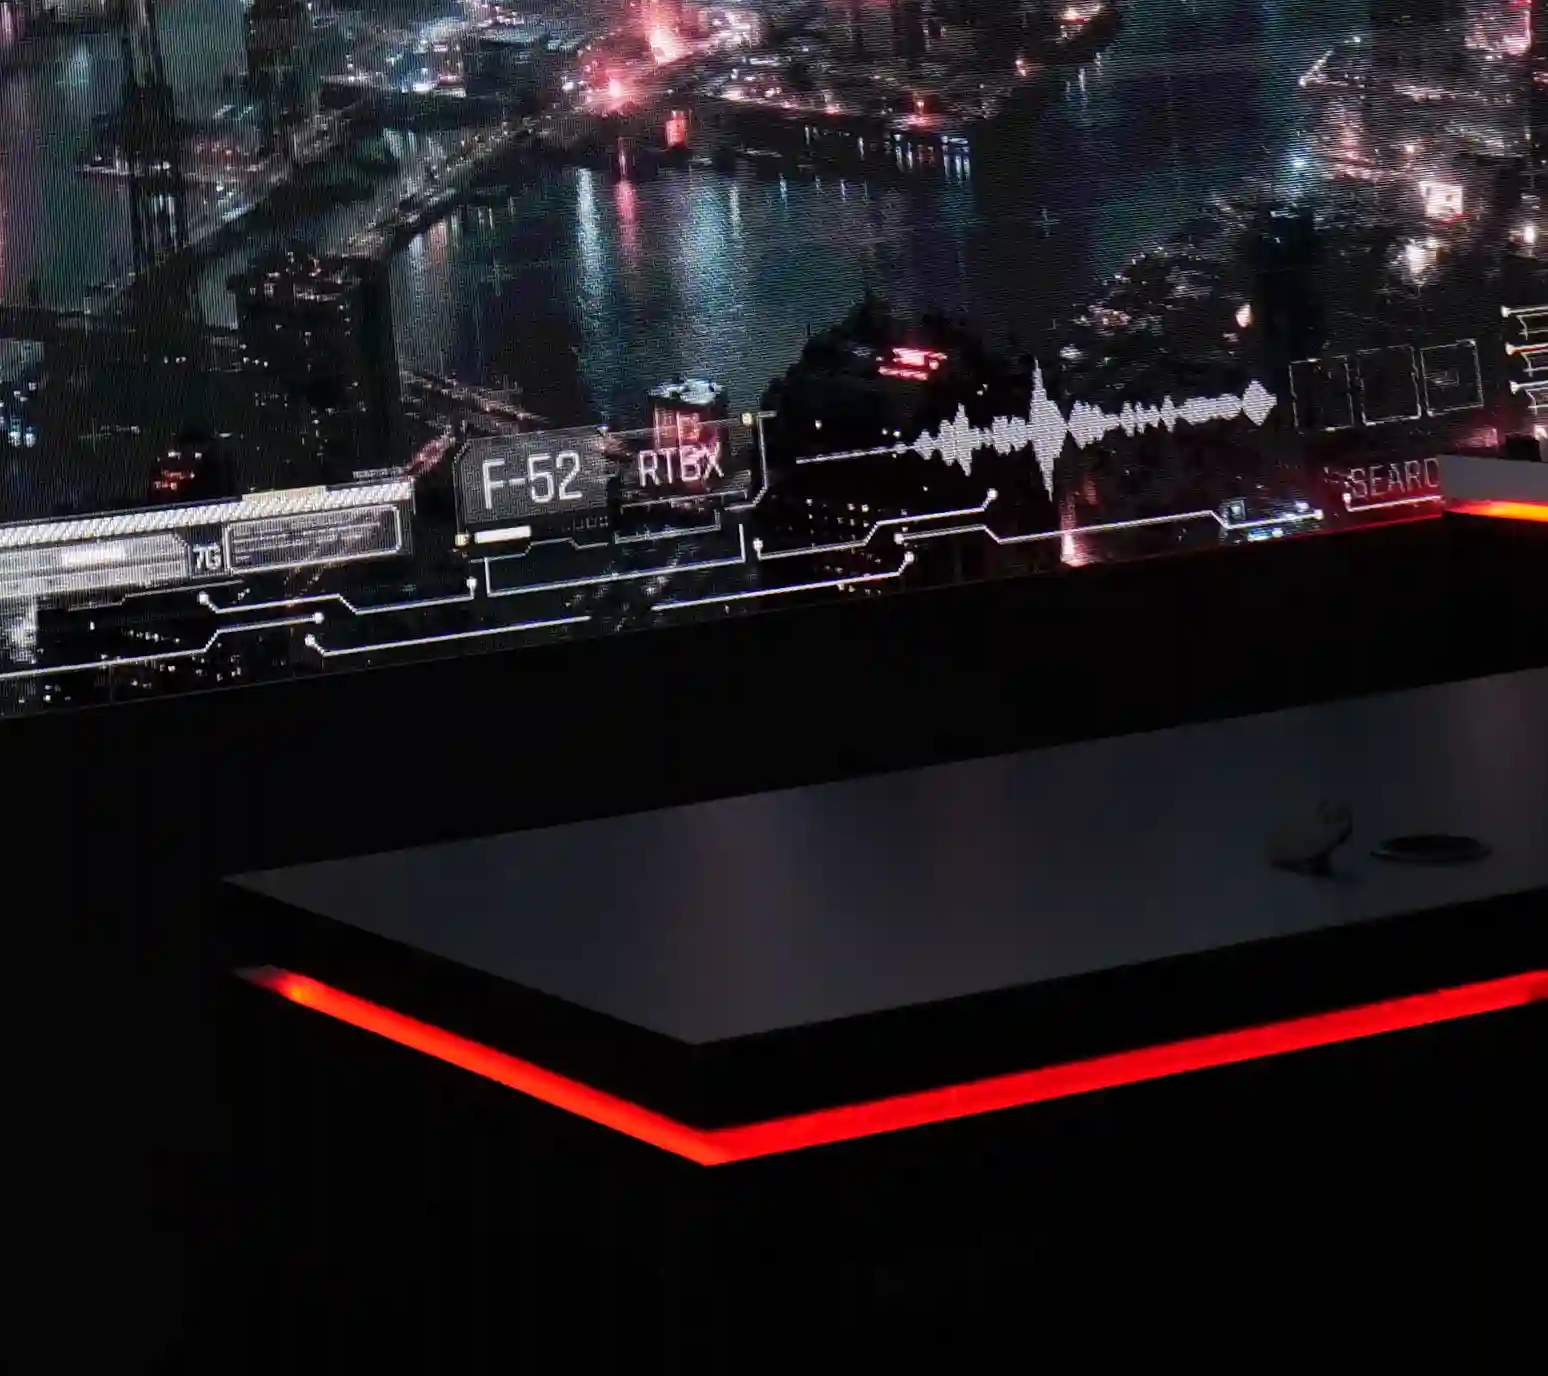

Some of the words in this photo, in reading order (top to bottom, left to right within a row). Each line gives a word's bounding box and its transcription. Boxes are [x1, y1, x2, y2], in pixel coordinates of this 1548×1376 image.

[481, 450, 582, 510] F-52
[637, 444, 724, 488] RTBX
[193, 540, 223, 574] 7G
